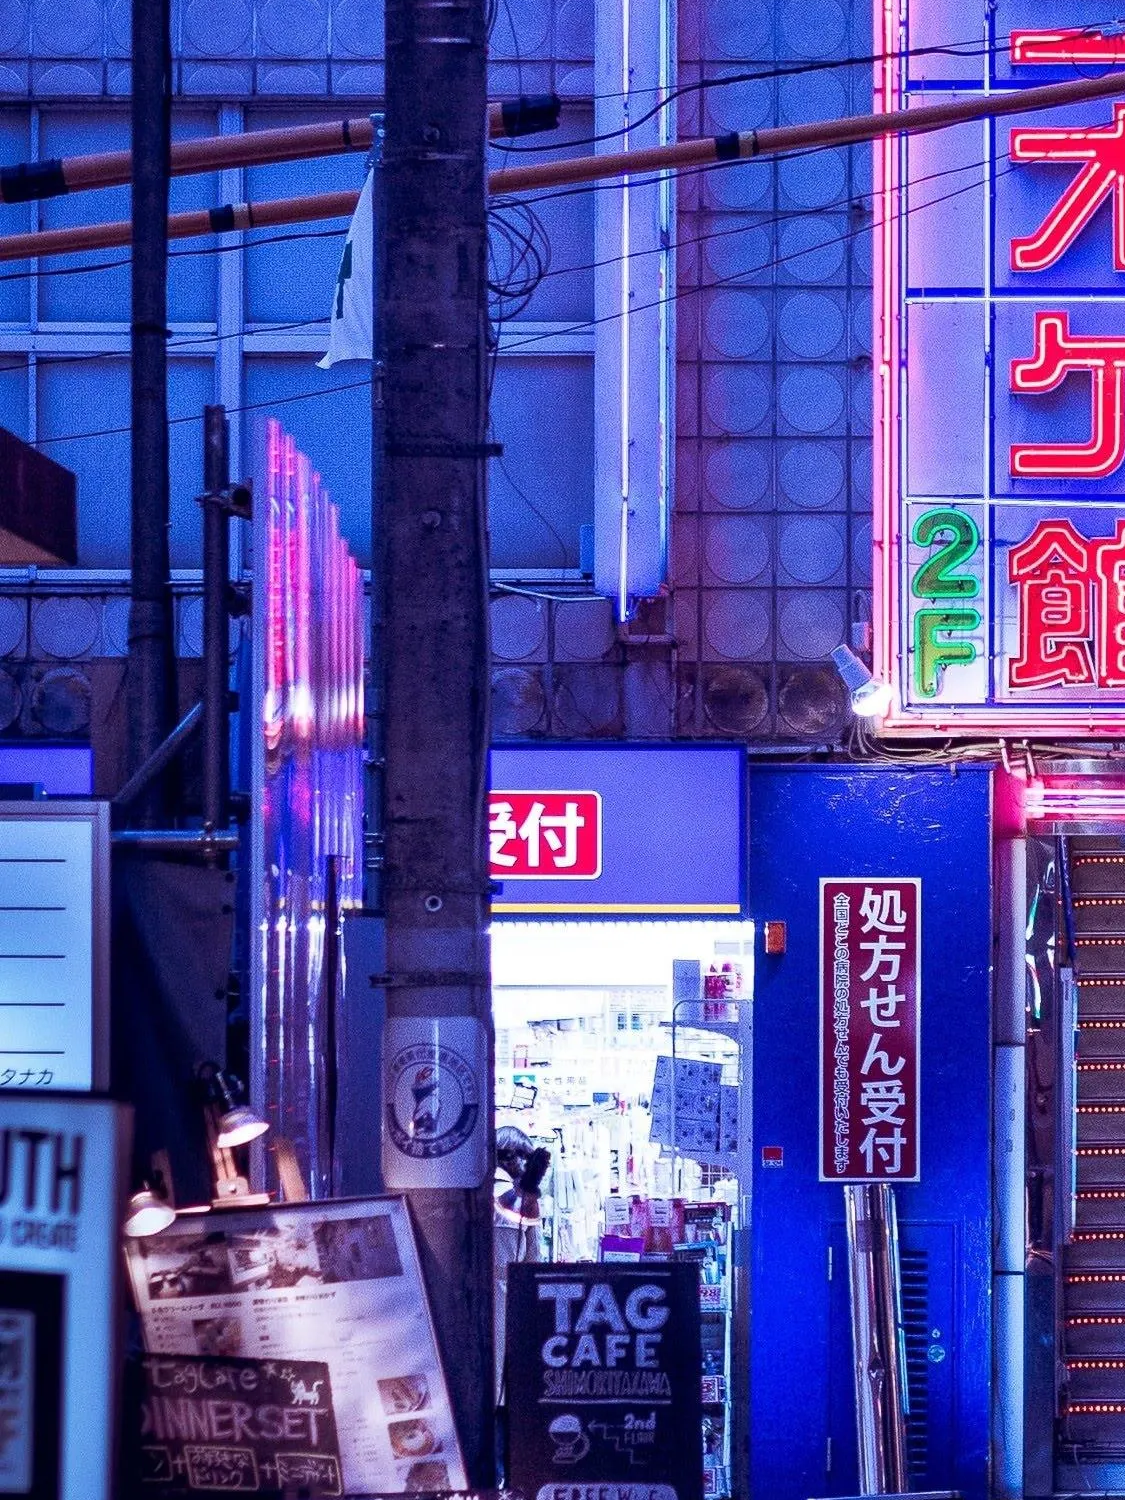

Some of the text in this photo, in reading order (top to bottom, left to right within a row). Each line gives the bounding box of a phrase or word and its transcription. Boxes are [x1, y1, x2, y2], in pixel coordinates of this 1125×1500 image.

[912, 508, 981, 698] 2F
[859, 887, 907, 1174] 処方せん受付
[537, 1283, 671, 1333] TAG
[541, 1333, 663, 1368] CAFE
[624, 1411, 656, 1430] 2nd
